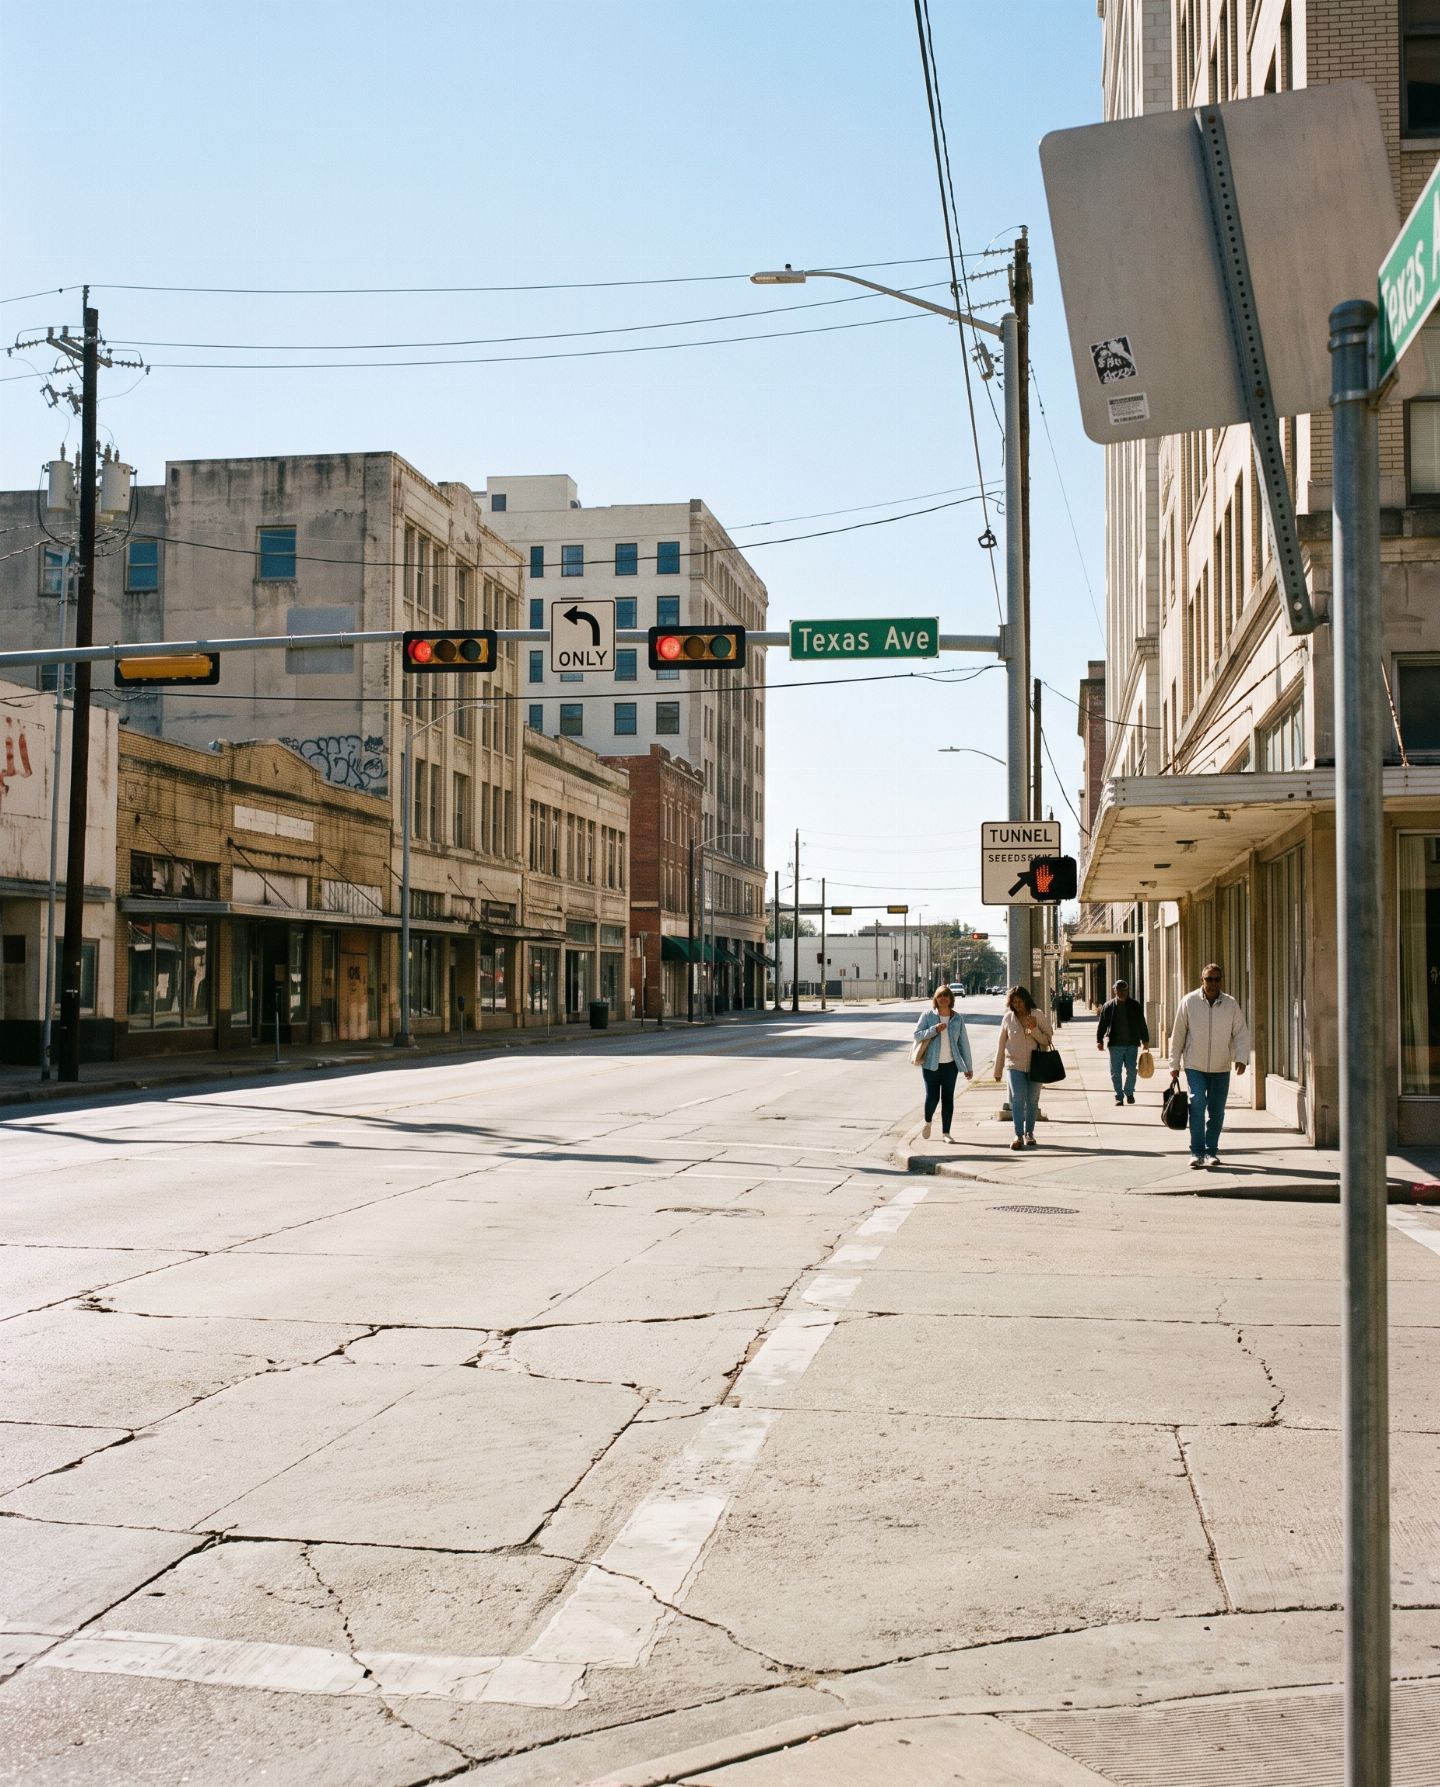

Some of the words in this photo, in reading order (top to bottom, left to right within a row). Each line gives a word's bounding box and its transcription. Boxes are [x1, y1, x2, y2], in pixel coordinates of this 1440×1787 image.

[1381, 240, 1425, 355] Texas
[799, 627, 870, 652] Texas
[884, 625, 930, 651] Ave
[559, 650, 607, 667] ONLY
[989, 829, 1052, 842] TUNNEL
